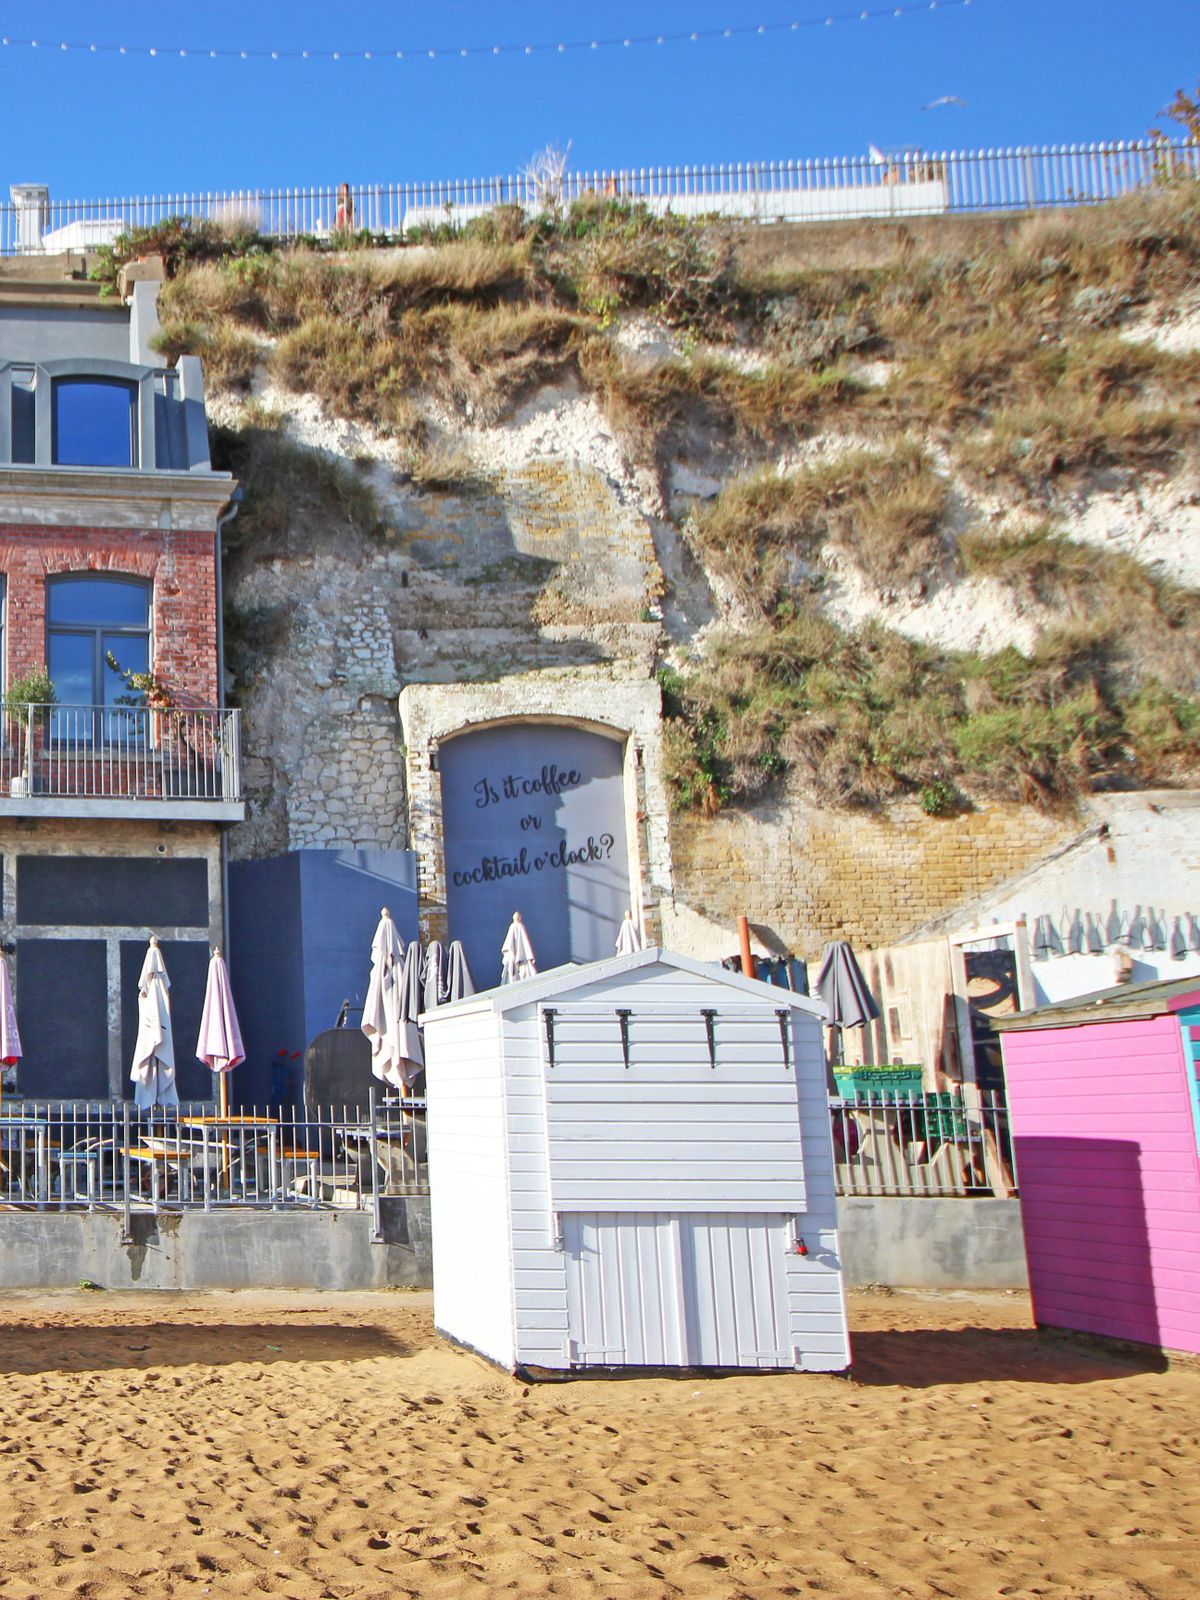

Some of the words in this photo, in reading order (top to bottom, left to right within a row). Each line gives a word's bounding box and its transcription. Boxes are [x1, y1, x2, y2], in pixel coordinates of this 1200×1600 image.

[473, 776, 500, 809] Is
[502, 775, 524, 799] it
[522, 764, 582, 796] coffee
[519, 814, 542, 831] or
[452, 847, 531, 887] cocktail
[533, 833, 615, 872] o'clock?
